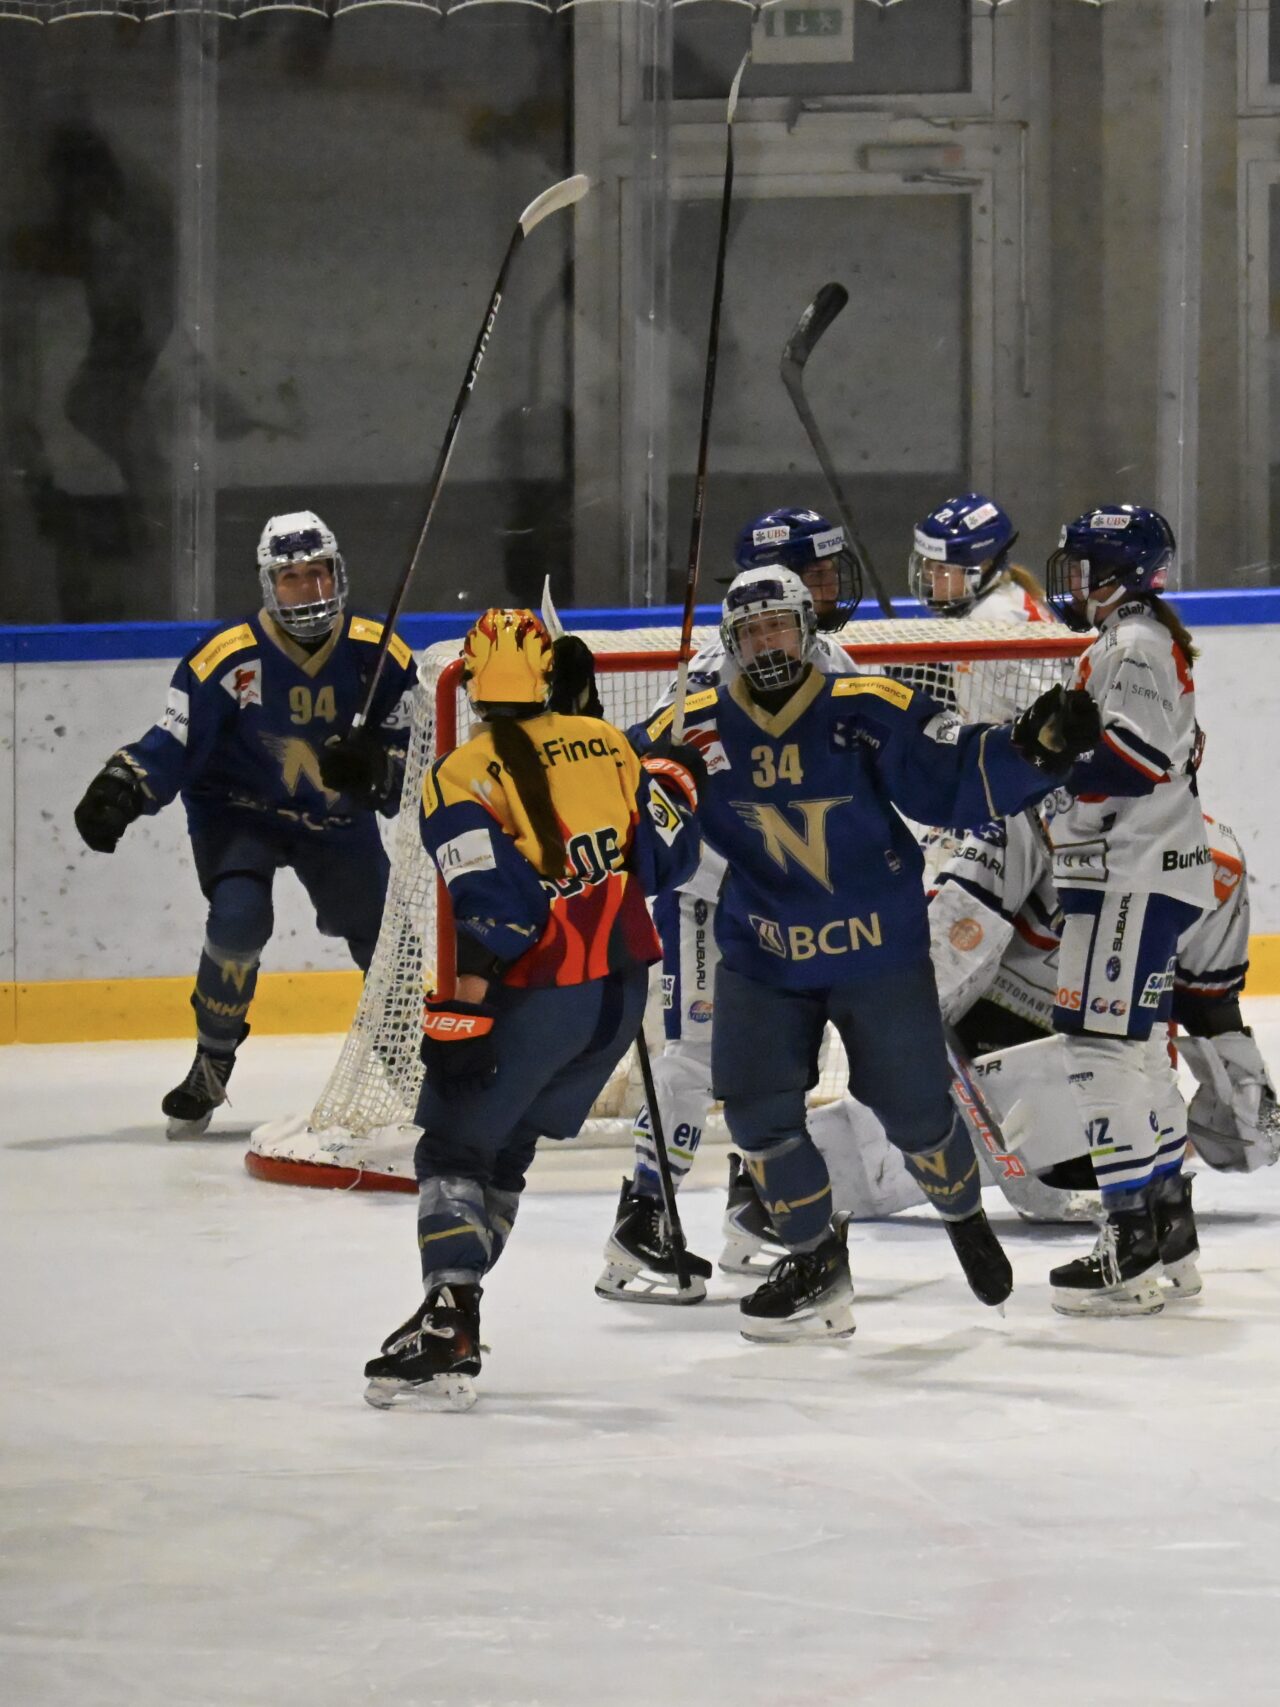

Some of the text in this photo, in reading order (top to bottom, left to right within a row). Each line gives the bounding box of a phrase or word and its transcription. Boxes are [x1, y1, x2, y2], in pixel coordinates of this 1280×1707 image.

[767, 530, 787, 539] UBS
[1106, 516, 1127, 526] UBS
[288, 685, 337, 726] 94
[848, 682, 908, 700] PostFinance
[751, 744, 804, 788] 34
[787, 912, 883, 961] BCN
[695, 929, 707, 991] SUBARU
